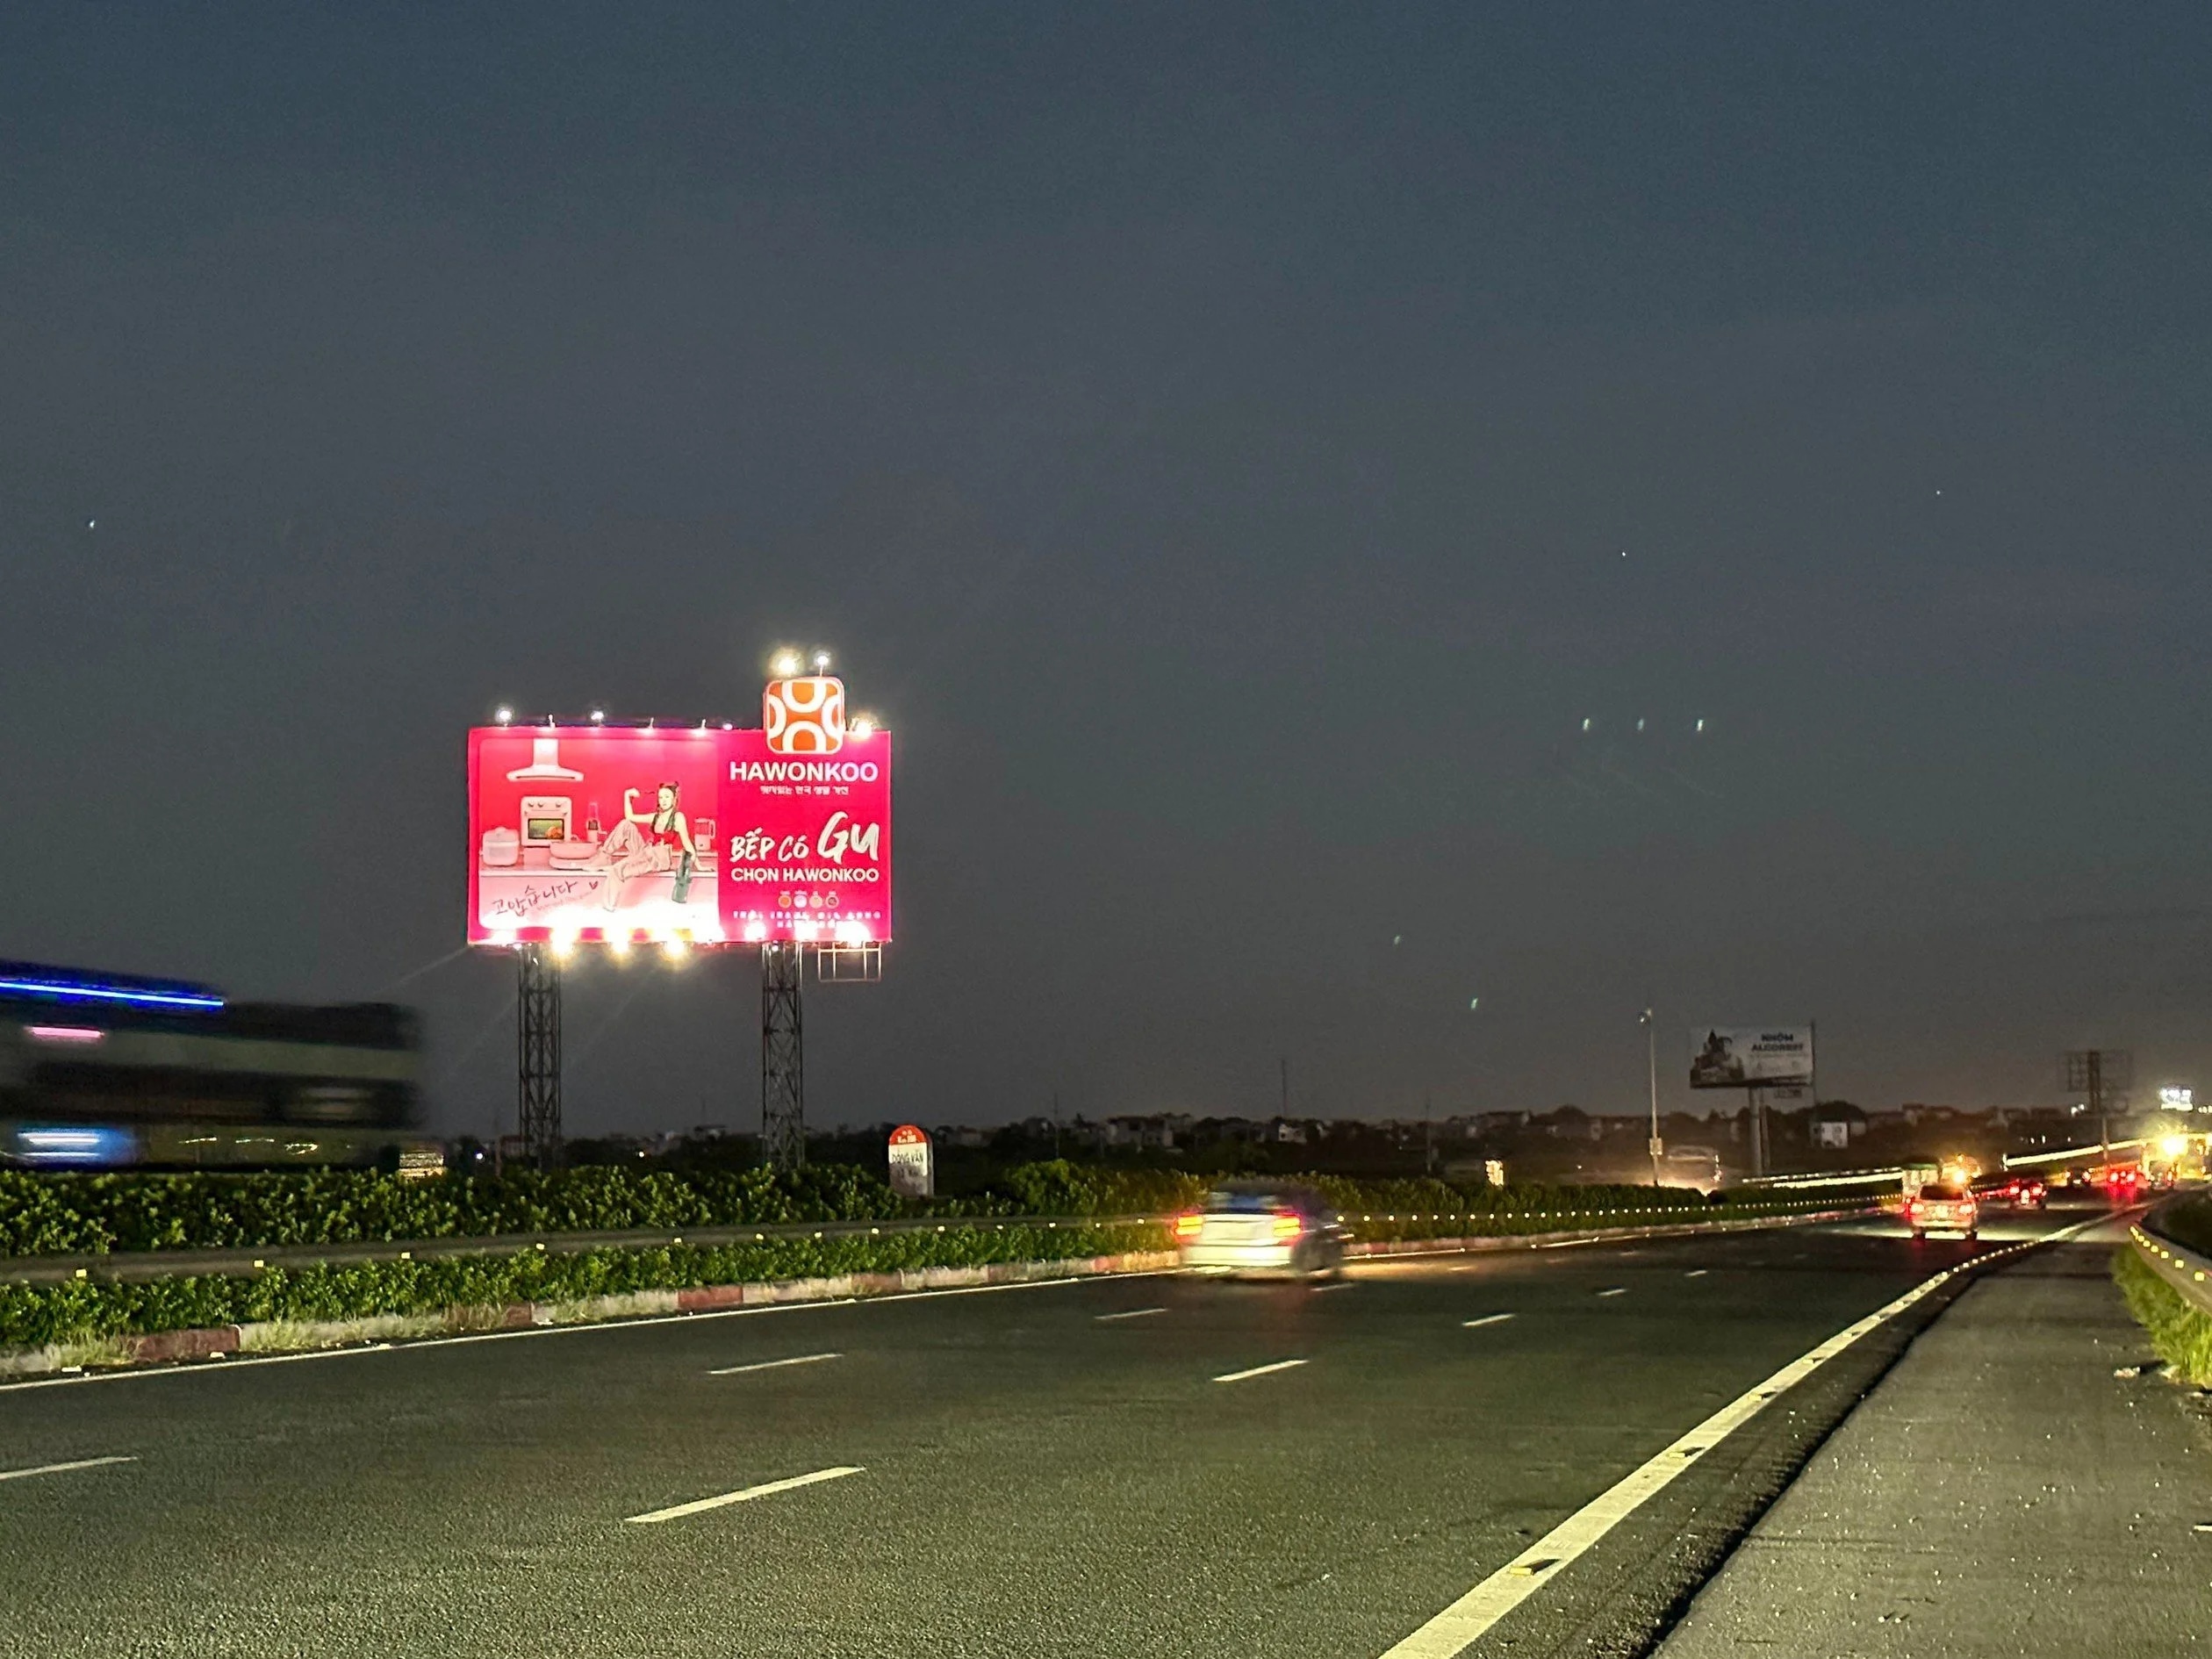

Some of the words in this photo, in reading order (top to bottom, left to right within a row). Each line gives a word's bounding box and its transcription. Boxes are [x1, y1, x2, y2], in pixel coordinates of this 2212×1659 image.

[729, 761, 879, 781] HAWONKOO
[729, 827, 776, 862] BẾP
[730, 867, 779, 884] CHỌN
[783, 867, 880, 882] HAWONKOO
